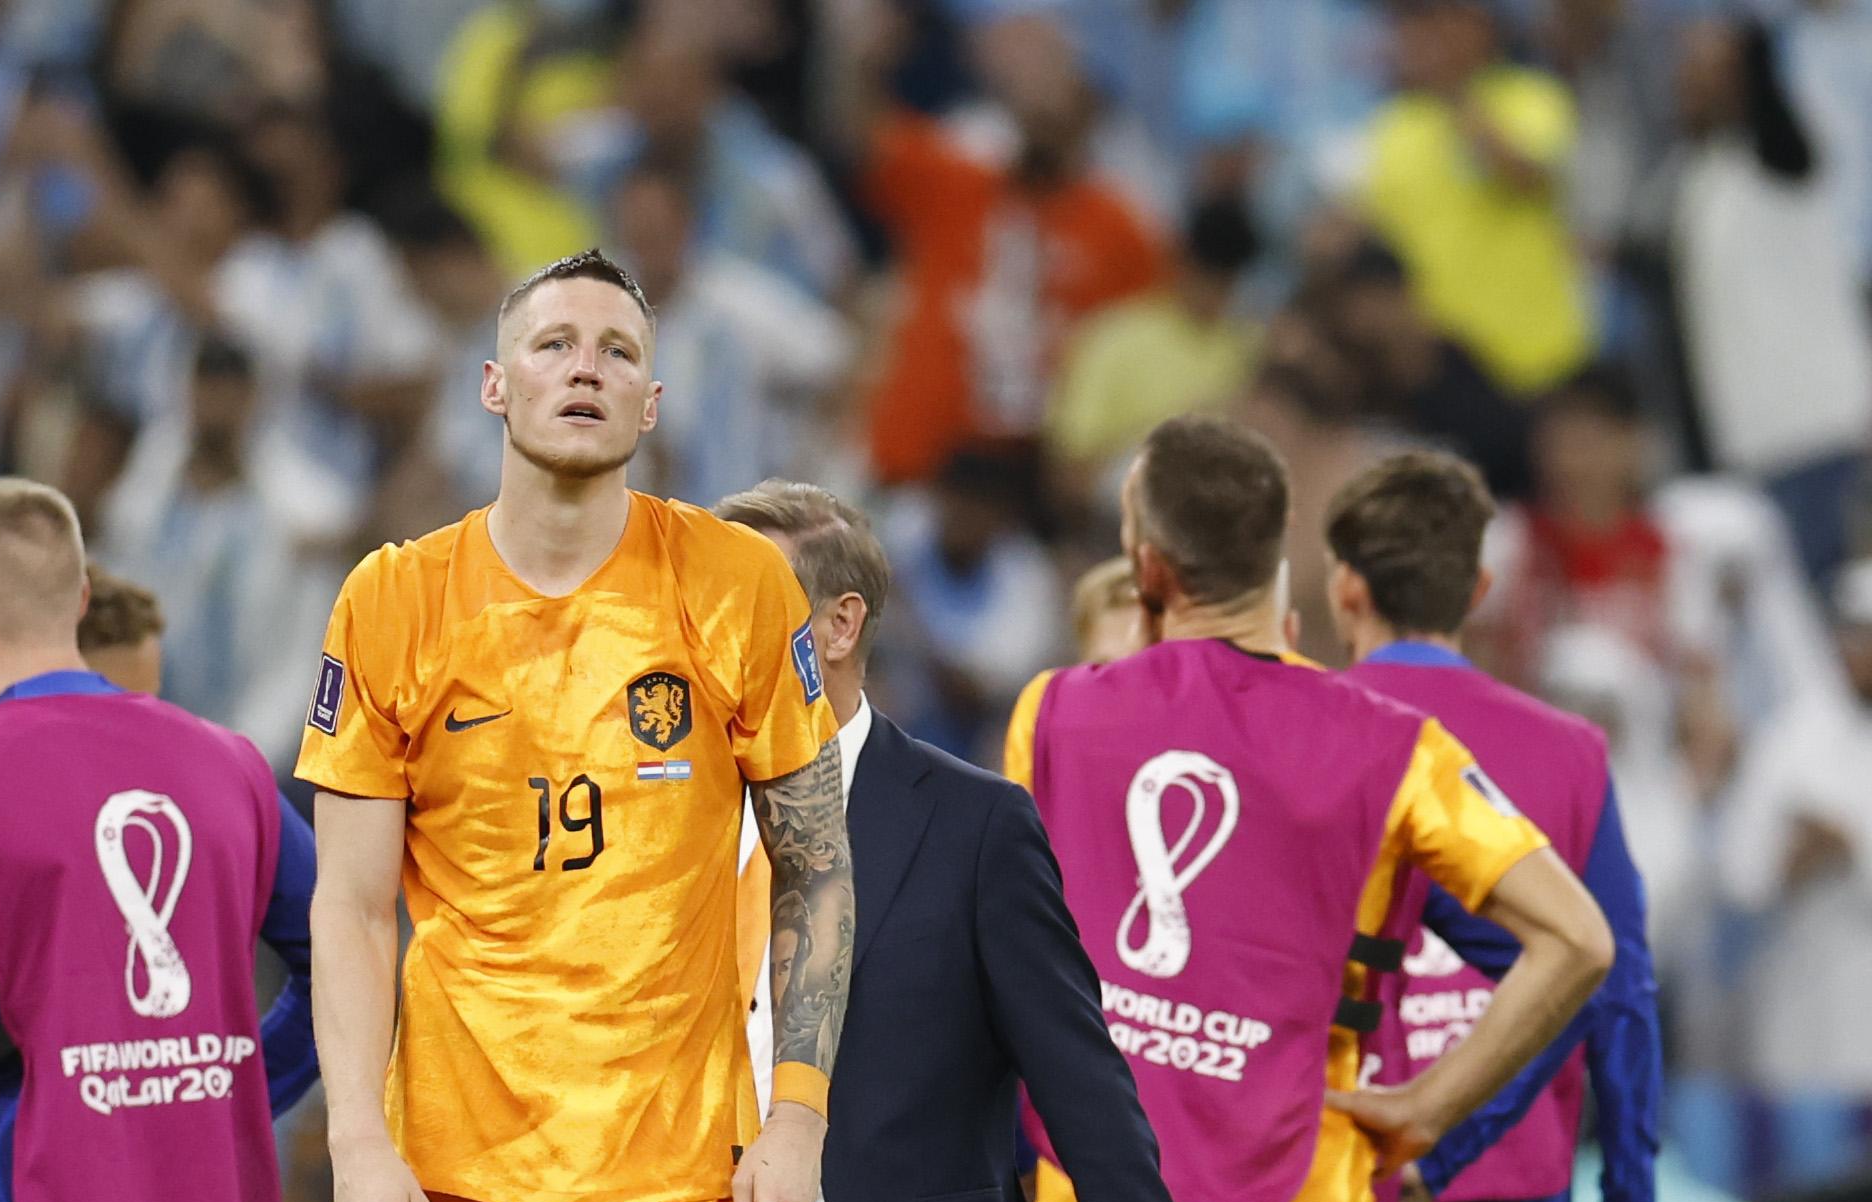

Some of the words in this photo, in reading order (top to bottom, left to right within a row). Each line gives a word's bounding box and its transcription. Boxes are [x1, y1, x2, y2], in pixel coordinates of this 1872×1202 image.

[527, 773, 605, 872] 19
[119, 1033, 222, 1071] WORLD
[1108, 1021, 1248, 1082] ar2022
[1202, 1010, 1273, 1049] CUP
